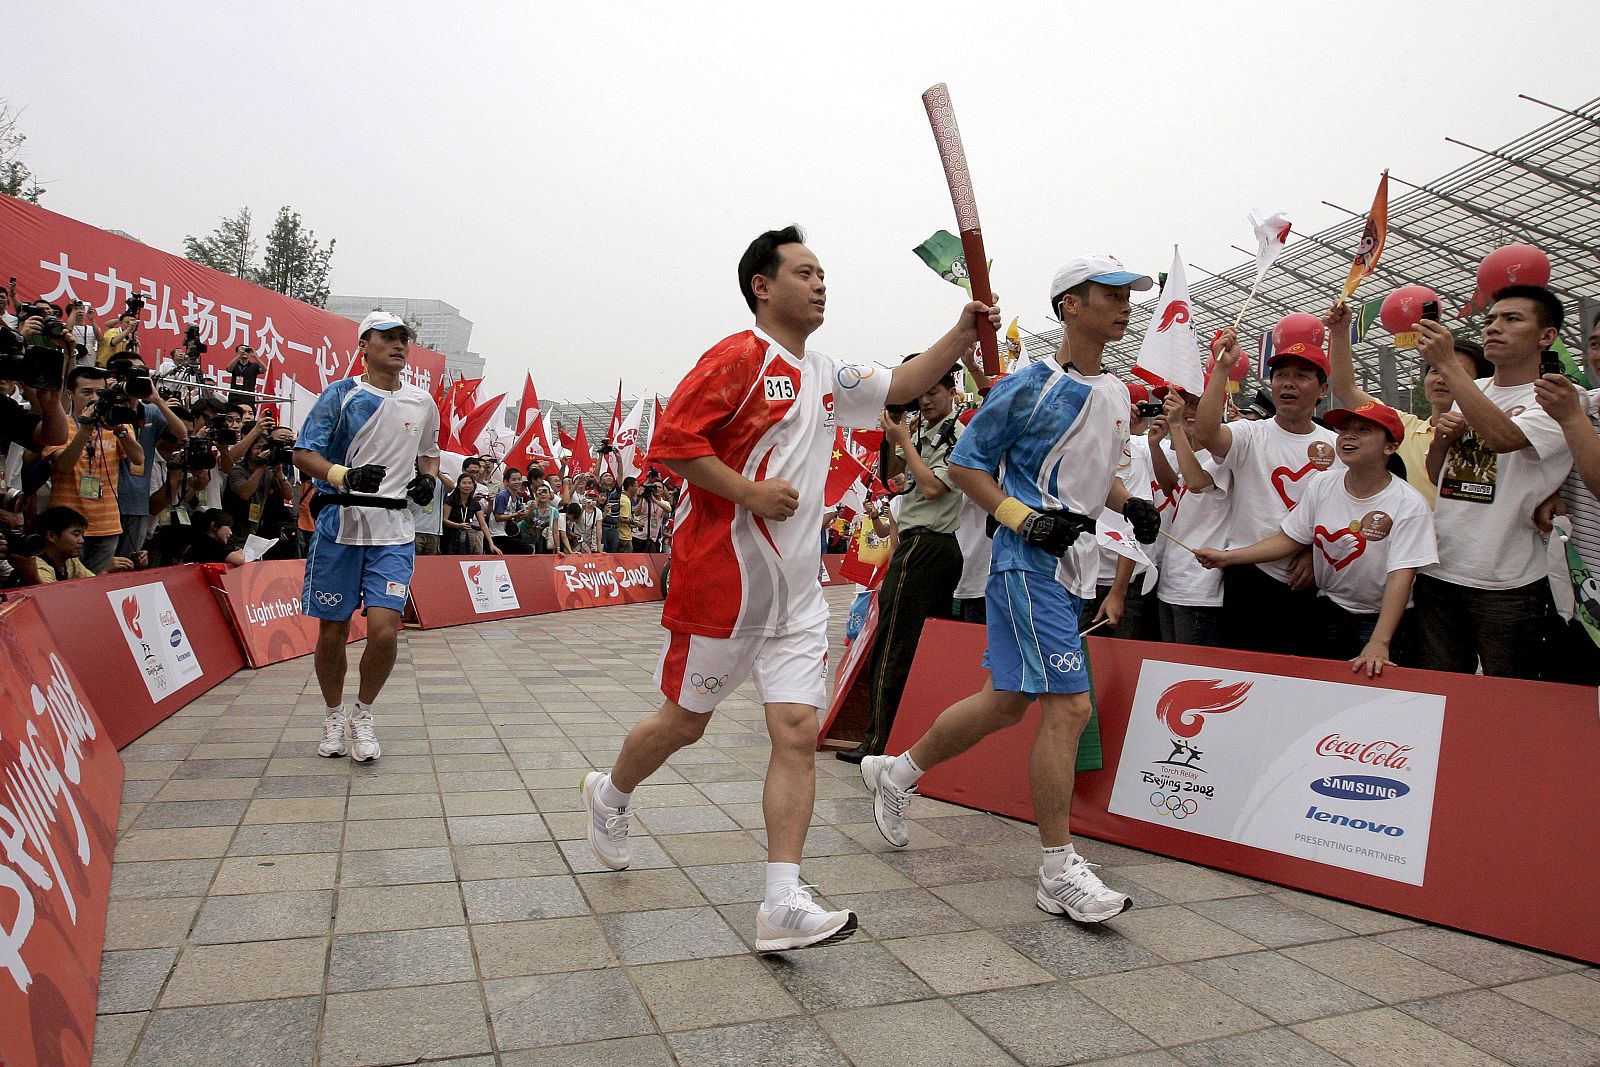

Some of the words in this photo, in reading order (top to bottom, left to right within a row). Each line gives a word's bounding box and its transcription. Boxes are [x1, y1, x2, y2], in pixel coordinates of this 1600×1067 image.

[766, 379, 793, 398] 315
[554, 562, 619, 598] Beijing
[615, 565, 654, 588] 2008
[245, 601, 277, 627] Light
[275, 598, 294, 618] the
[1315, 733, 1415, 769] Coca-Cola
[1140, 770, 1181, 792] Beijing
[1183, 782, 1215, 797] 2008
[1161, 766, 1179, 776] Torch
[1180, 769, 1199, 780] Relay
[1322, 776, 1398, 800] SAMSUNG
[1305, 805, 1405, 837] lenovo
[1294, 833, 1353, 853] PRESENTING
[1355, 846, 1407, 865] PARTNERS
